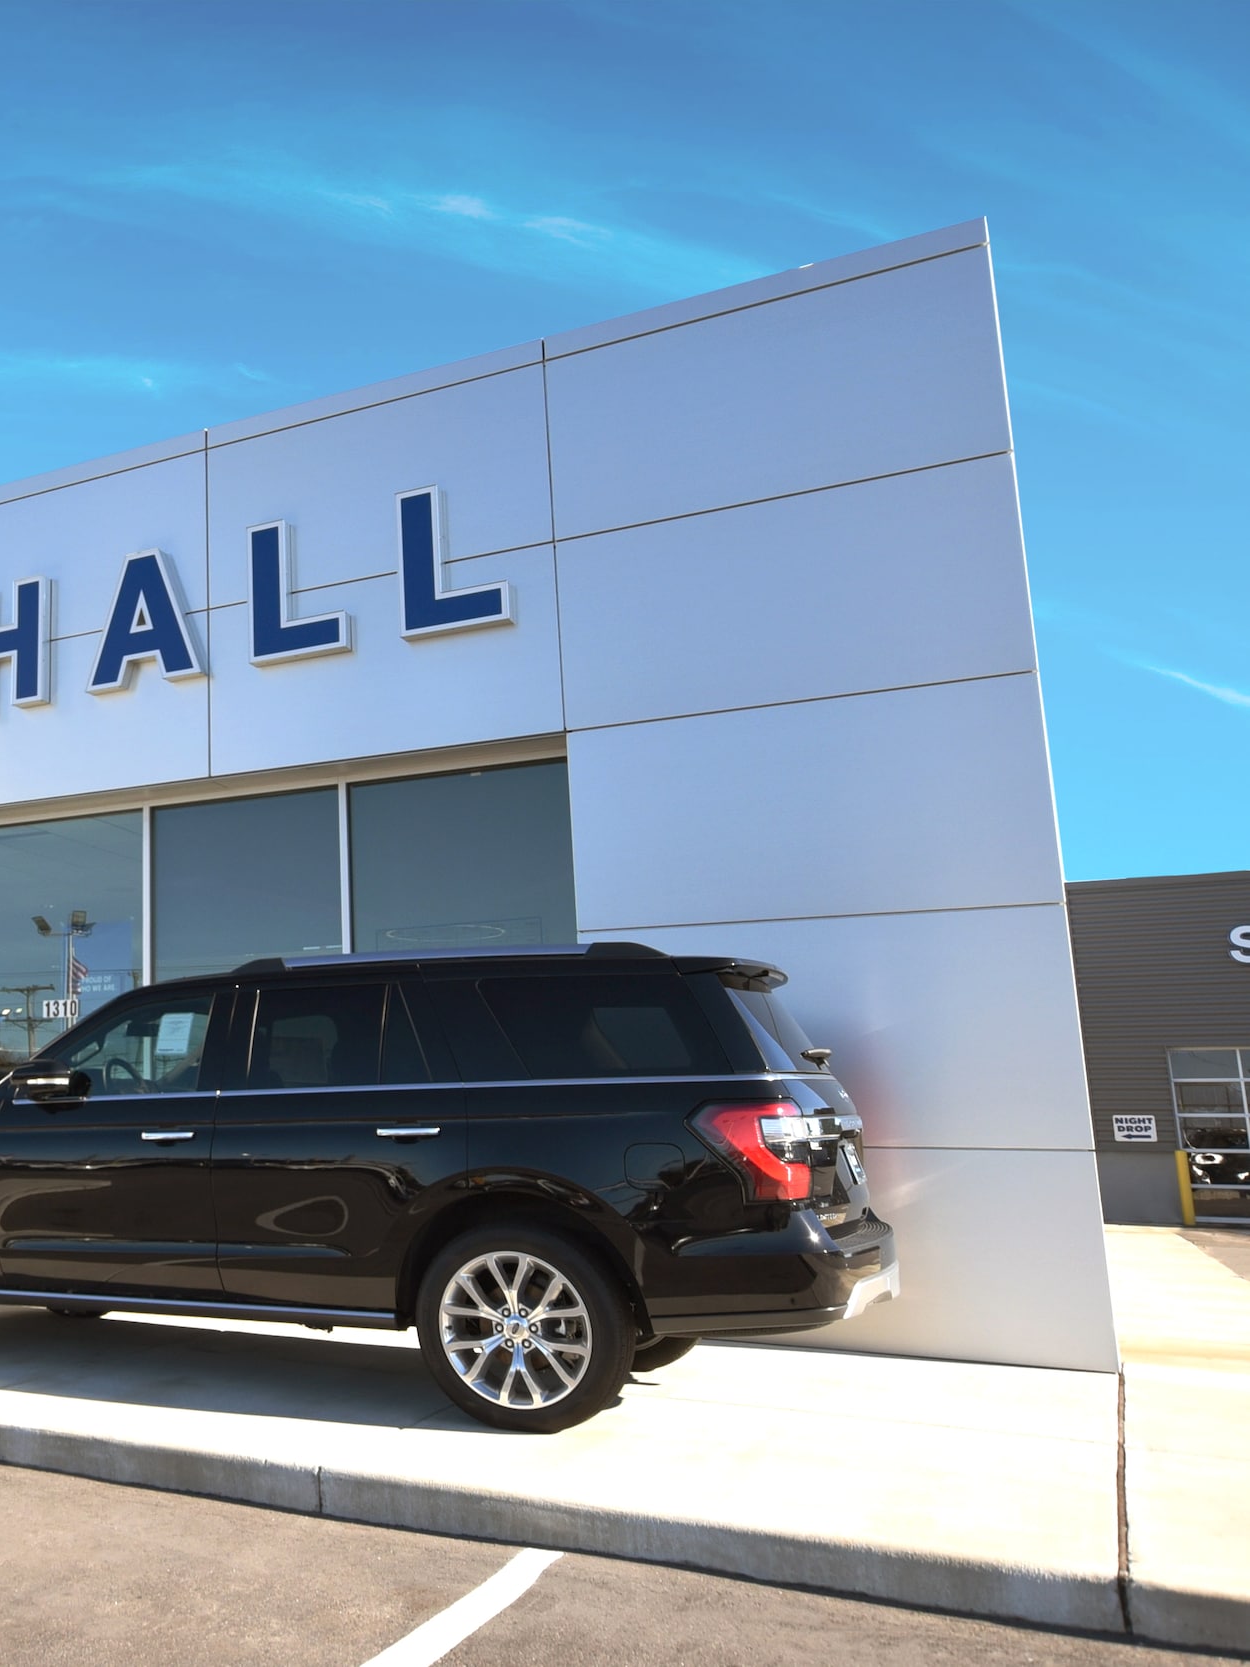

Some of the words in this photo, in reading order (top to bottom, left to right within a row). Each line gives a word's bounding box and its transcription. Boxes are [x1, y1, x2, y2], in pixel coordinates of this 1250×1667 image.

[45, 1000, 77, 1017] 1310
[1114, 1117, 1153, 1125] NIGHT
[1117, 1125, 1152, 1133] DROP
